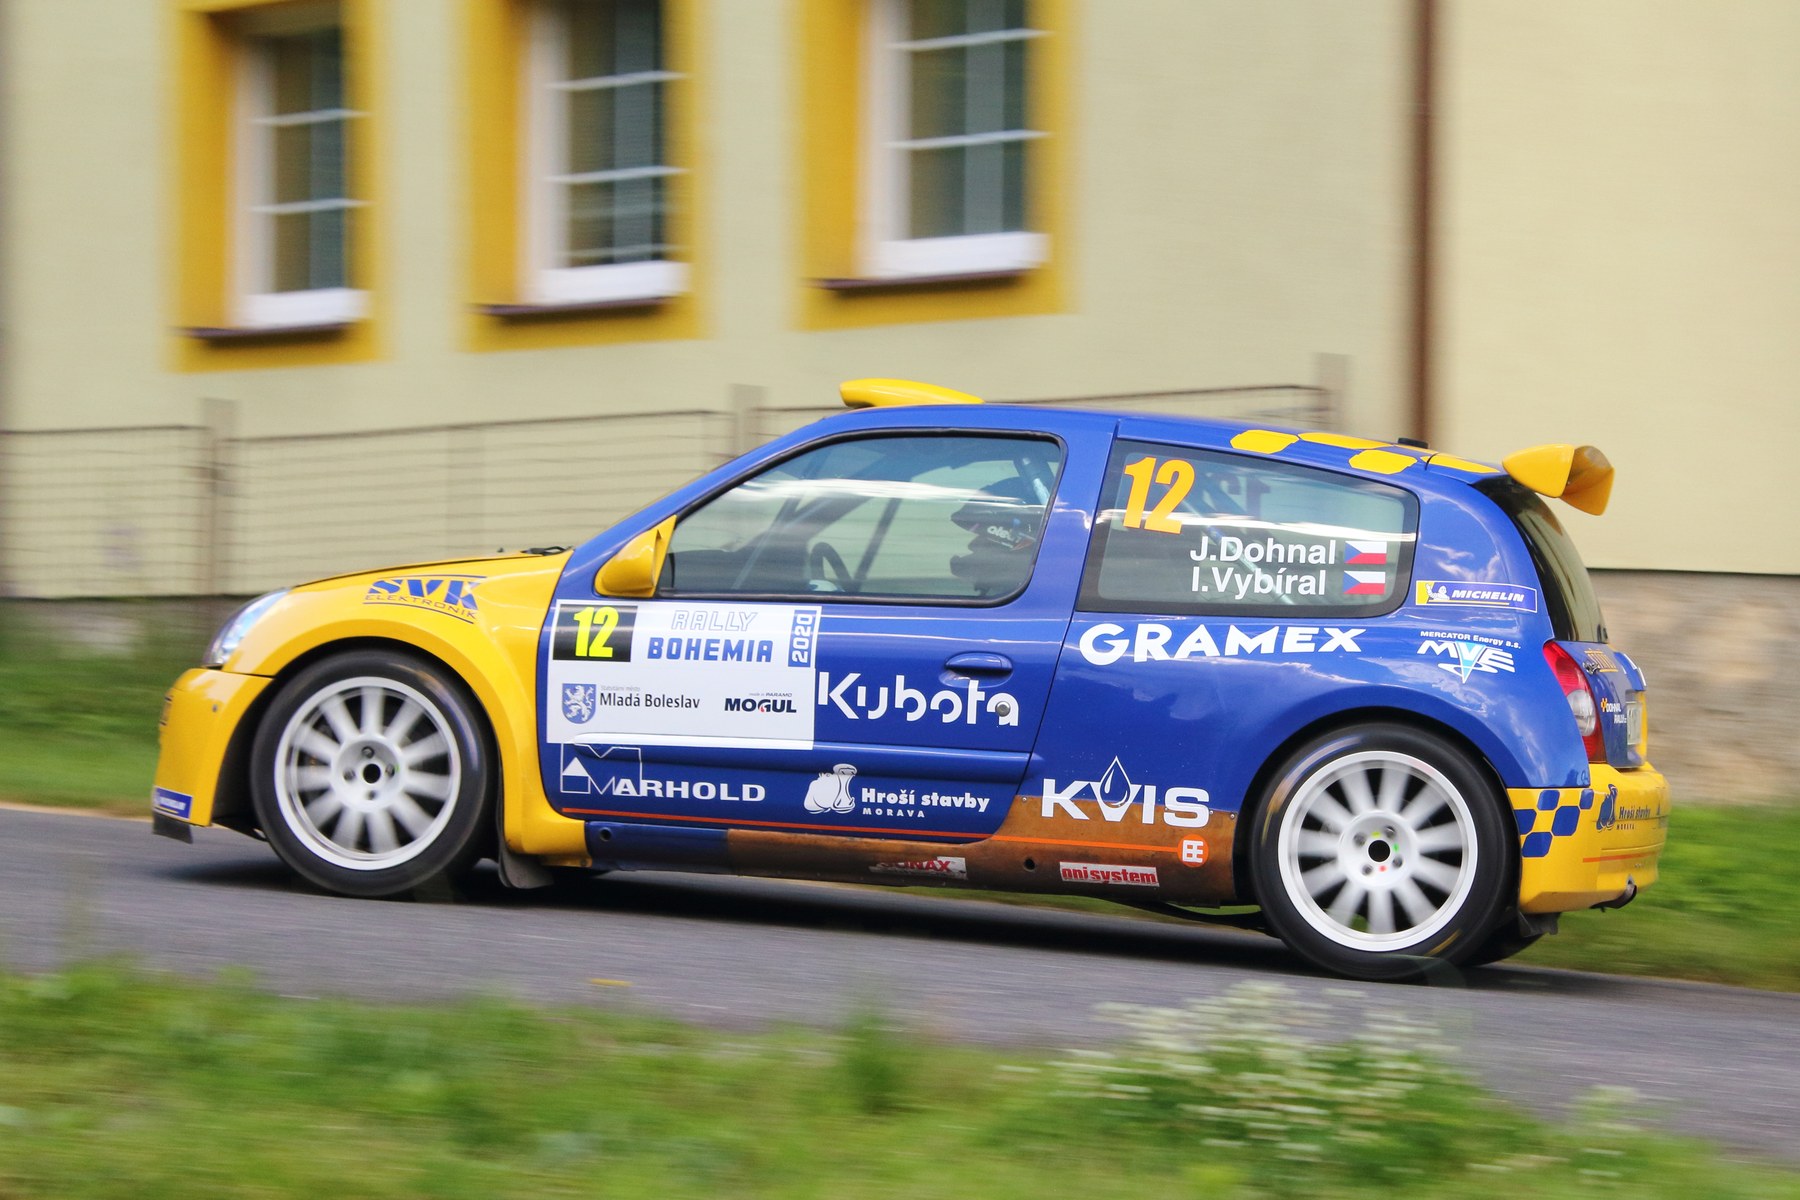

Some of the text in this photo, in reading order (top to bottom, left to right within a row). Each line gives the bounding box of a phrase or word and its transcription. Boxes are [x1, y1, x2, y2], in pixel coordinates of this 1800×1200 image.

[1123, 457, 1195, 534] 12
[1190, 536, 1336, 565] J.Dohnal
[368, 579, 480, 611] SVK
[1191, 566, 1326, 600] I.Vybíral
[1451, 590, 1525, 602] MICHELIN
[365, 594, 477, 619] ELEKTRONIK
[670, 609, 759, 632] RALLY
[573, 606, 619, 659] 12
[791, 613, 813, 664] 2020
[1079, 622, 1367, 666] GRAMEX
[1420, 630, 1471, 641] MERCATOR
[1473, 635, 1504, 646] Energy
[647, 636, 774, 663] BOHEMIA
[1417, 640, 1515, 683] MVE
[600, 692, 700, 708] Mladá Boleslav
[724, 698, 797, 713] MOGUL
[818, 671, 1019, 727] Kubota
[861, 787, 990, 813] Hroší stavby
[862, 807, 925, 818] MORAVA
[1042, 777, 1210, 828] KVIS
